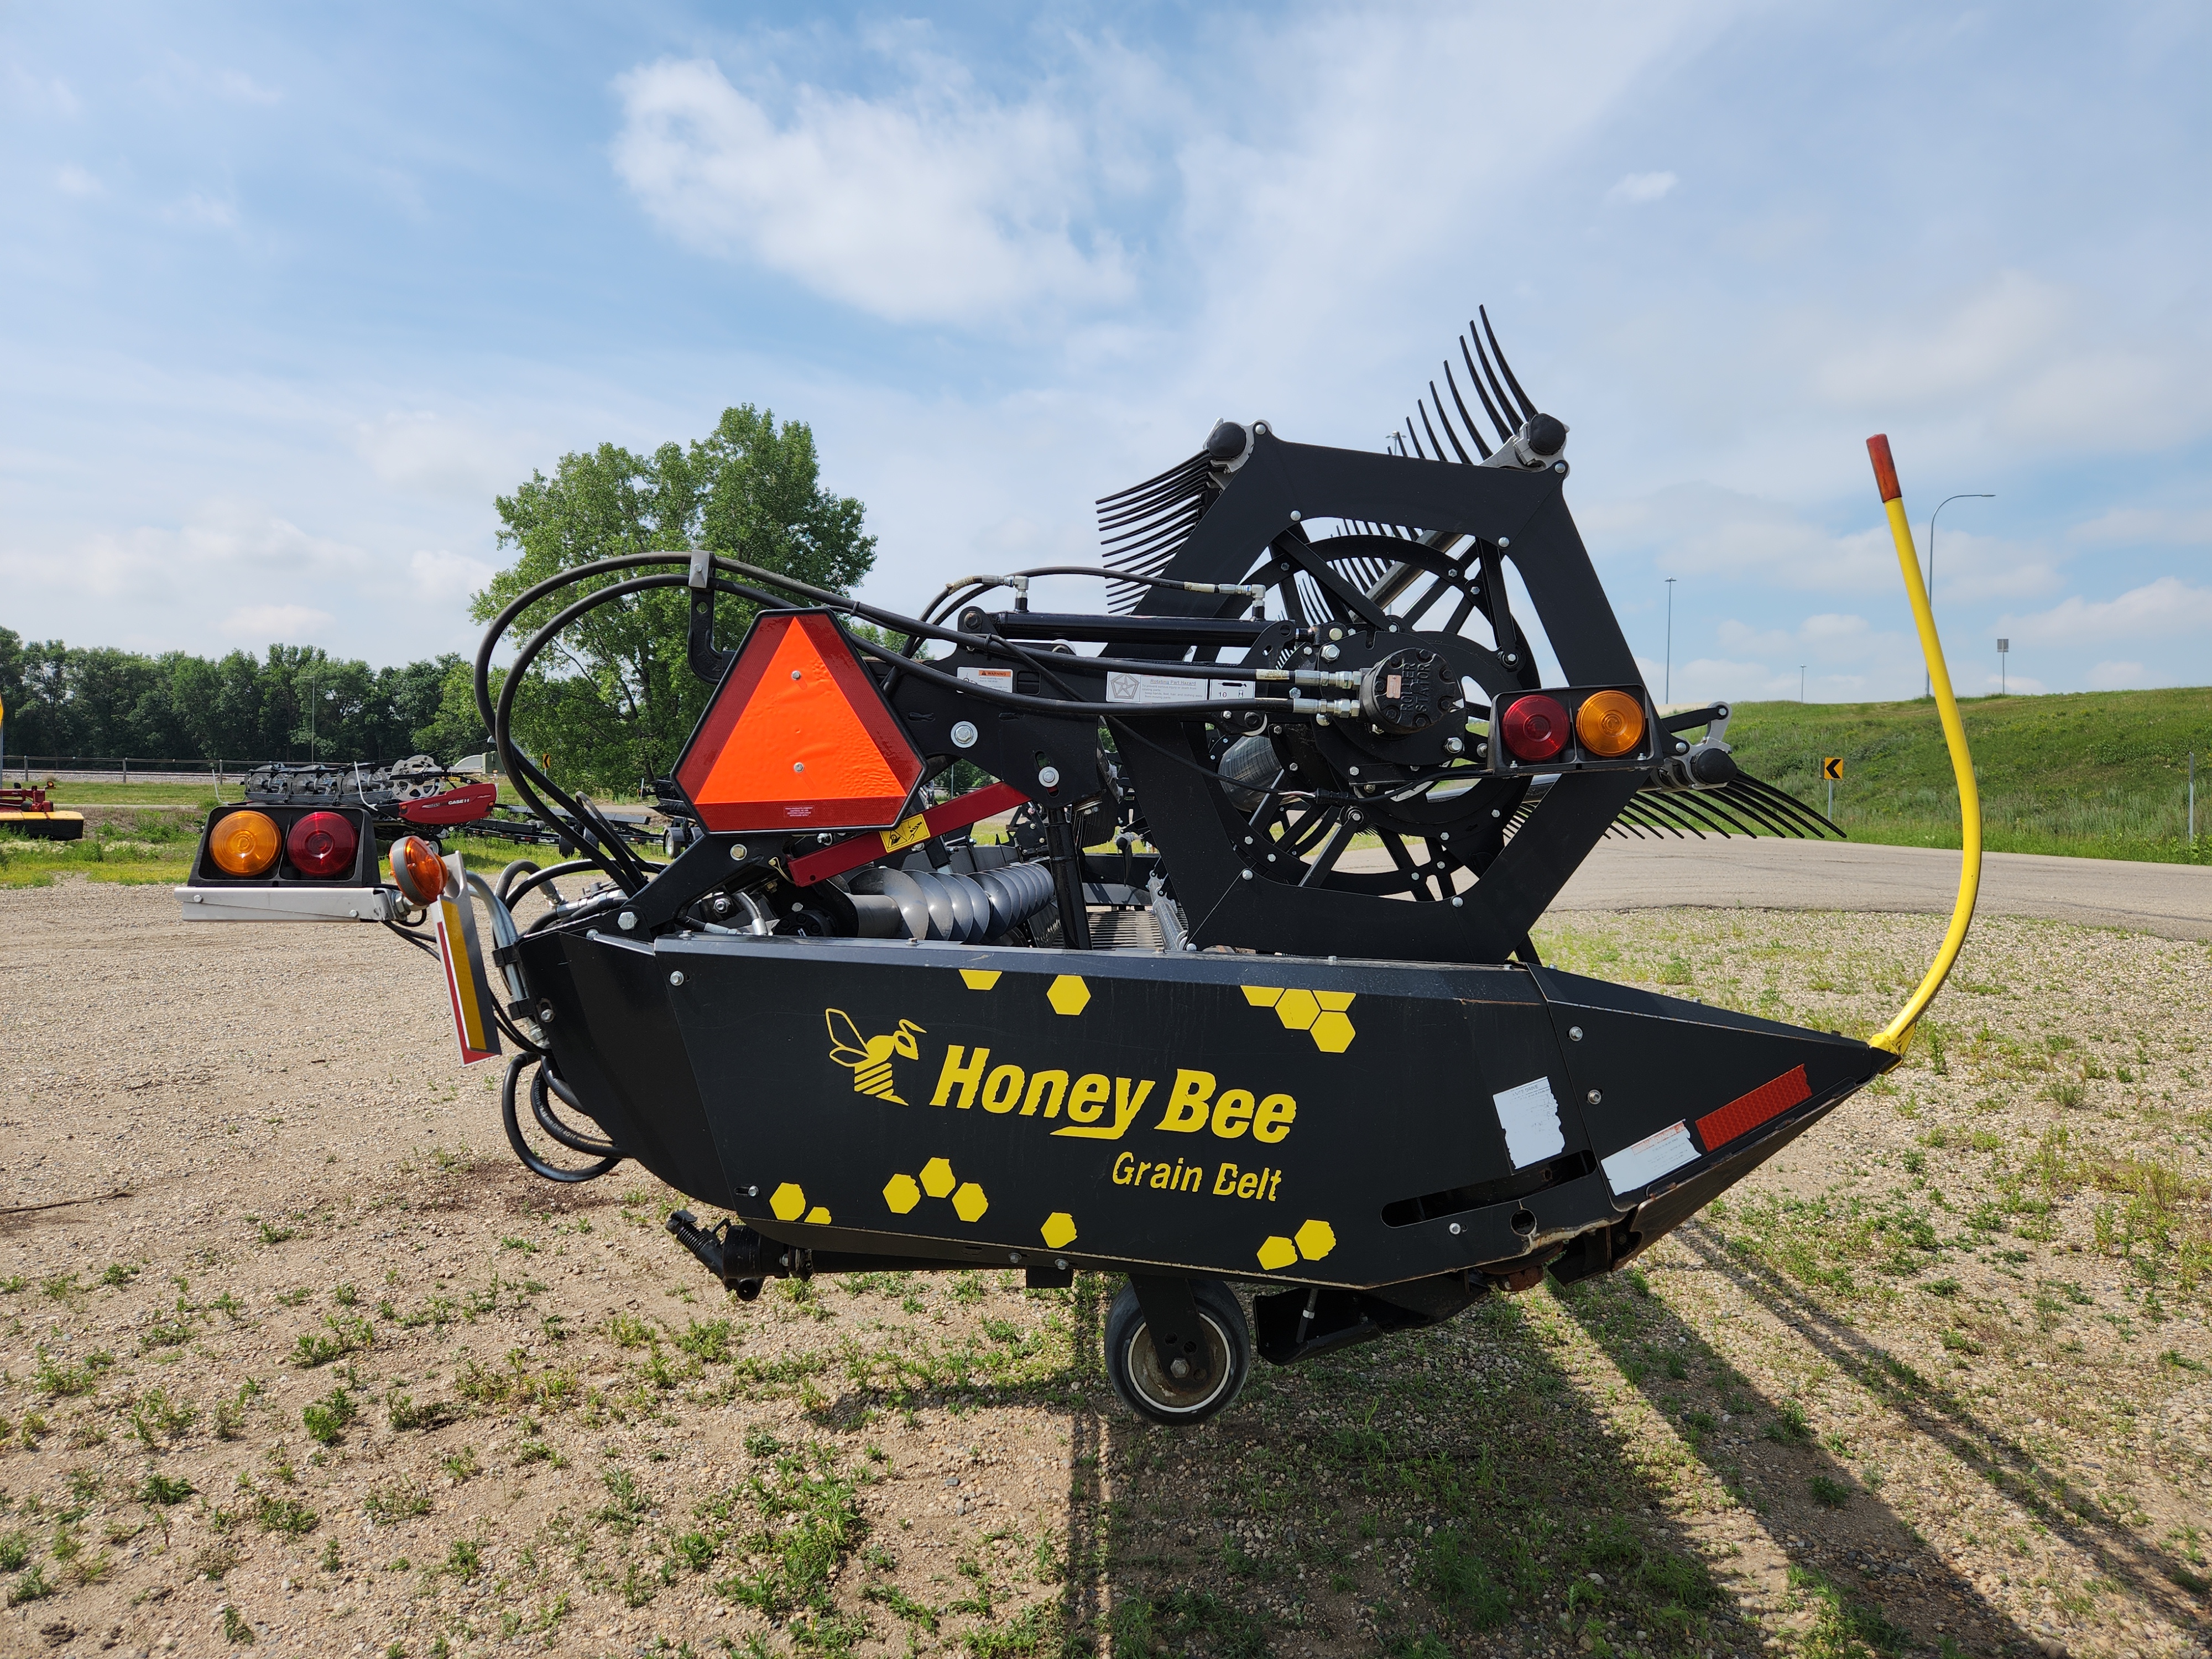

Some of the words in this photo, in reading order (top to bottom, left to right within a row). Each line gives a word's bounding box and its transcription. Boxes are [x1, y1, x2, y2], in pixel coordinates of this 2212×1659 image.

[1400, 662, 1416, 712] ROLLER
[1415, 663, 1431, 712] STATOR
[929, 1044, 1155, 1139] Honey
[1154, 1068, 1297, 1143] Bee
[1525, 1084, 1538, 1093] DRIVE
[1112, 1151, 1203, 1192] Grain
